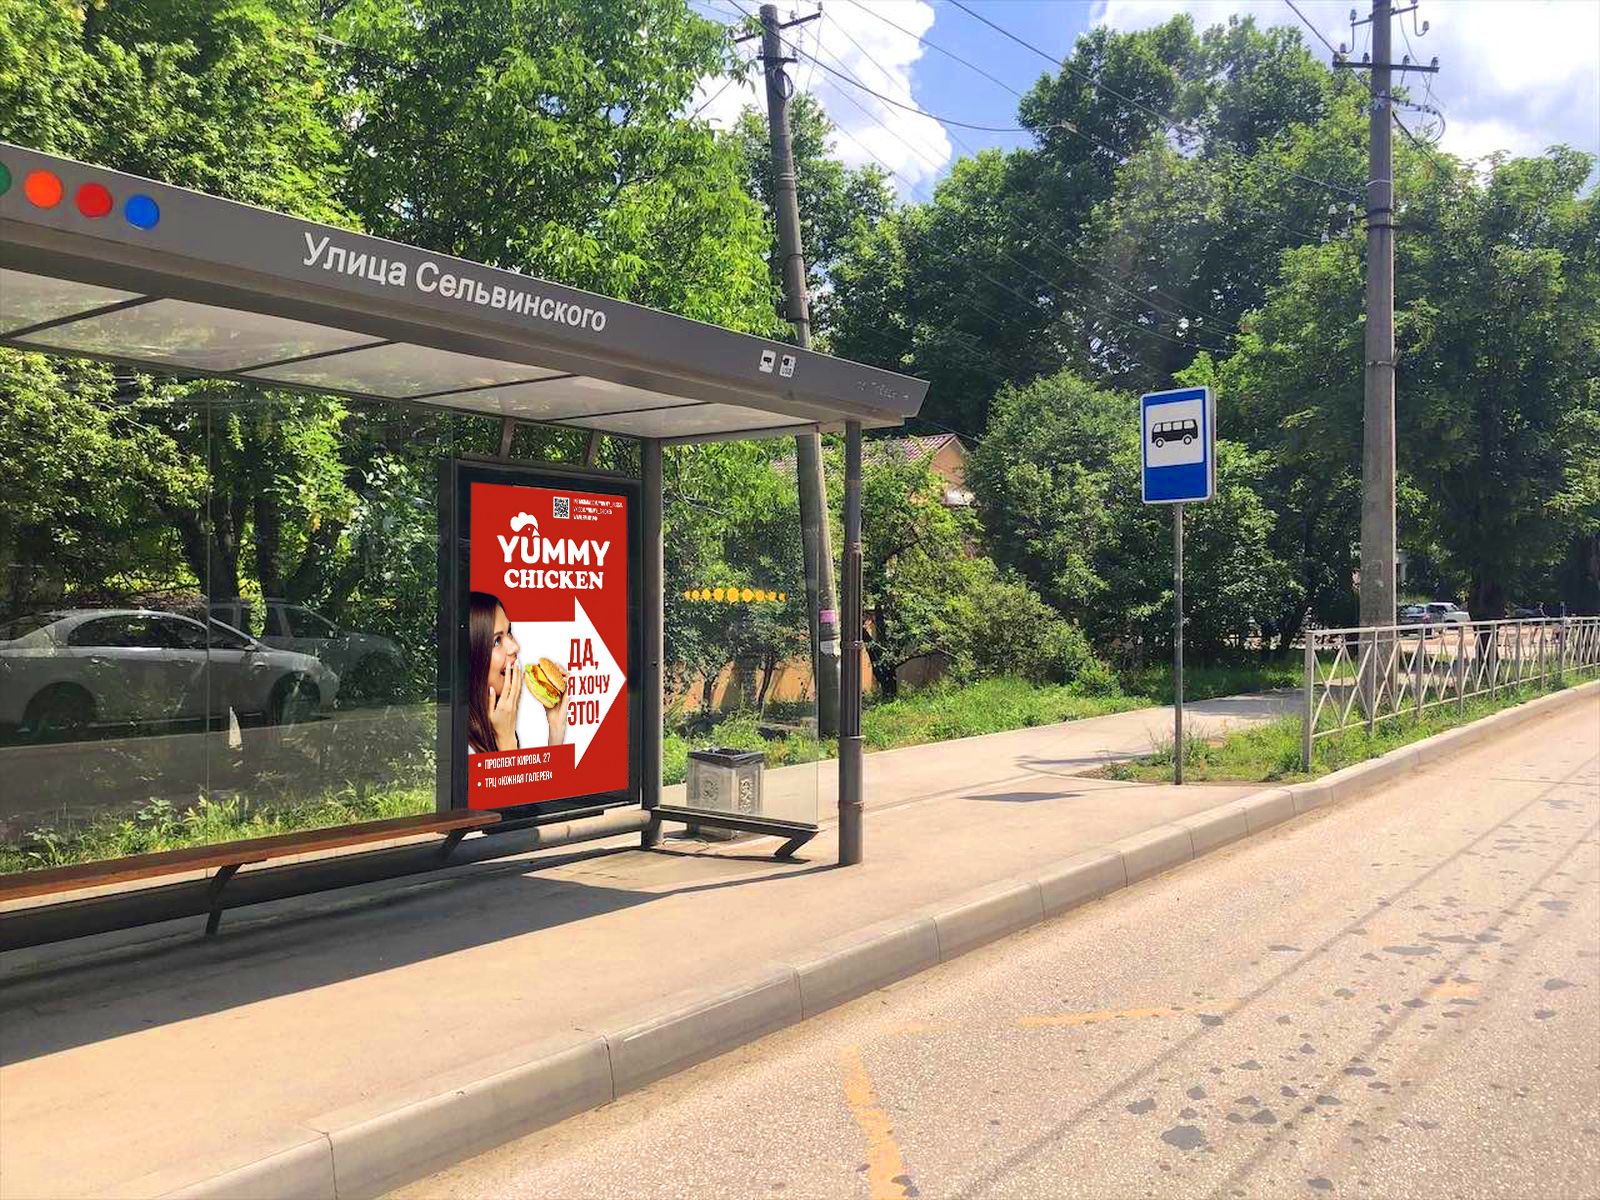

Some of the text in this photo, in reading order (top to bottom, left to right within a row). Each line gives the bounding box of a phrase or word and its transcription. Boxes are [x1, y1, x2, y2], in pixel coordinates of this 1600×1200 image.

[303, 232, 607, 332] Улица Сельвинского
[497, 534, 611, 567] YUMMY
[503, 568, 604, 590] CHICKEN
[567, 638, 600, 672] ДА,
[567, 674, 611, 697] Я ХОЧУ
[567, 700, 600, 727] ЭТО!
[484, 752, 551, 770] ПРОСПЕКТ КИРОВА, 27
[484, 777, 497, 788] ТРЦ
